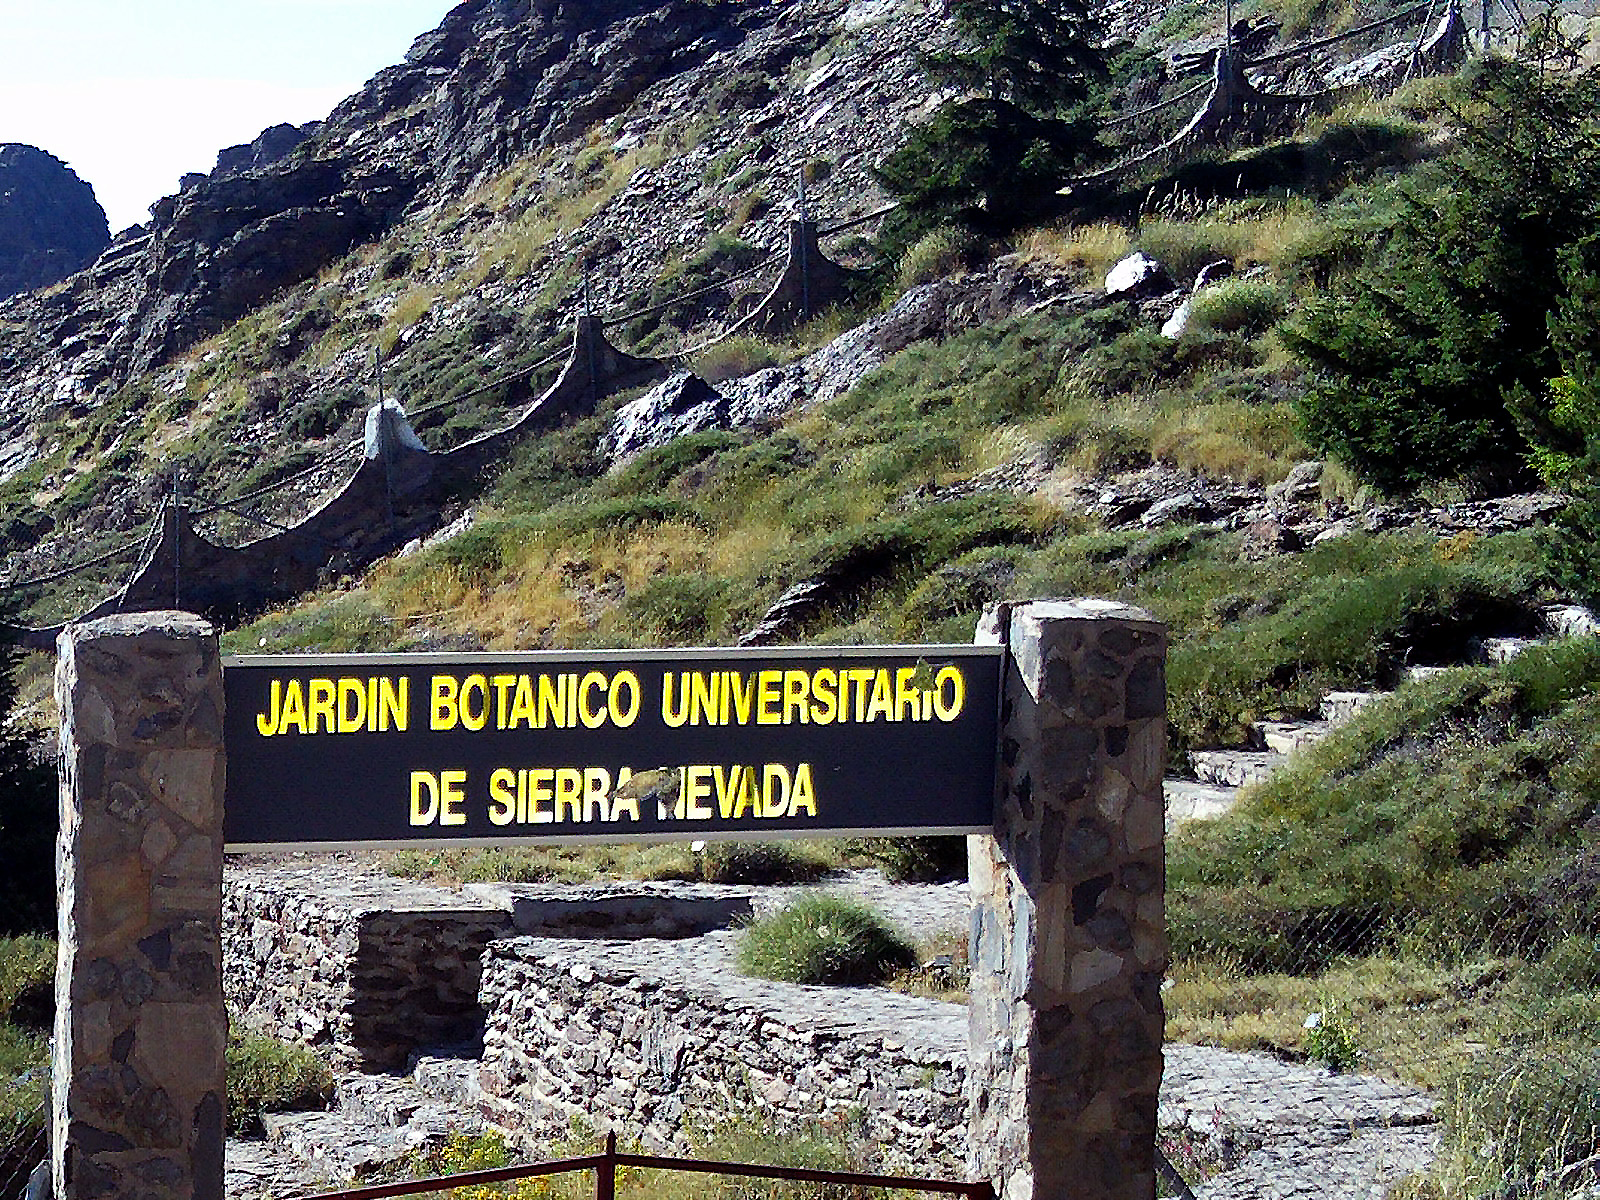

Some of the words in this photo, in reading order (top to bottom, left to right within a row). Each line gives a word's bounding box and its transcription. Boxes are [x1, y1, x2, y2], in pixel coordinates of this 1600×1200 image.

[257, 676, 409, 737] JARDIN
[429, 670, 642, 732] BOTANICO
[409, 770, 468, 826] DE
[488, 766, 641, 826] SIERRA
